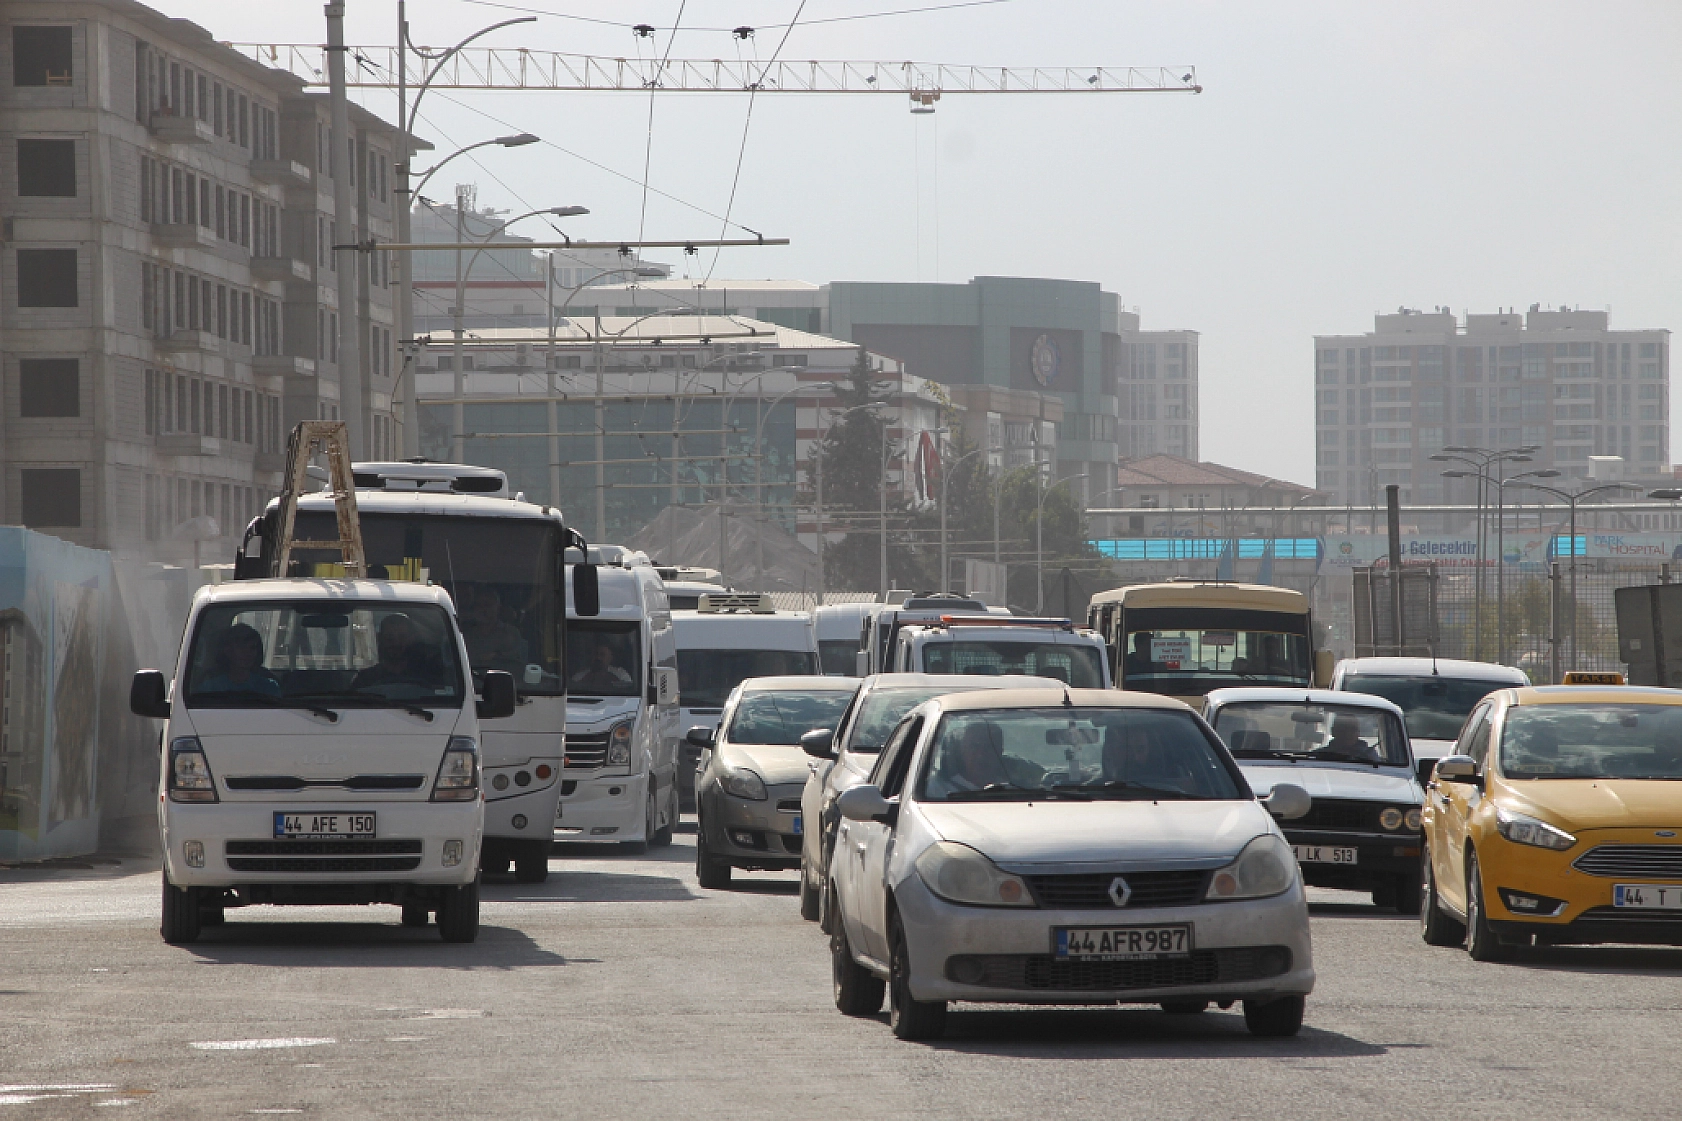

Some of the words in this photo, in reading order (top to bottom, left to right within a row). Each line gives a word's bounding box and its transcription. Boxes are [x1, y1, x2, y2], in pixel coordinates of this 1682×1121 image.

[1411, 541, 1477, 554] Gelecektir
[1610, 541, 1668, 555] HOSPITAL
[285, 816, 302, 832] 44
[311, 816, 338, 832] AFE
[348, 816, 373, 832] 150
[1307, 848, 1321, 860] LK
[1333, 849, 1353, 862] 513
[1625, 888, 1644, 905] 44
[1658, 888, 1667, 906] T
[1068, 931, 1095, 953] 44
